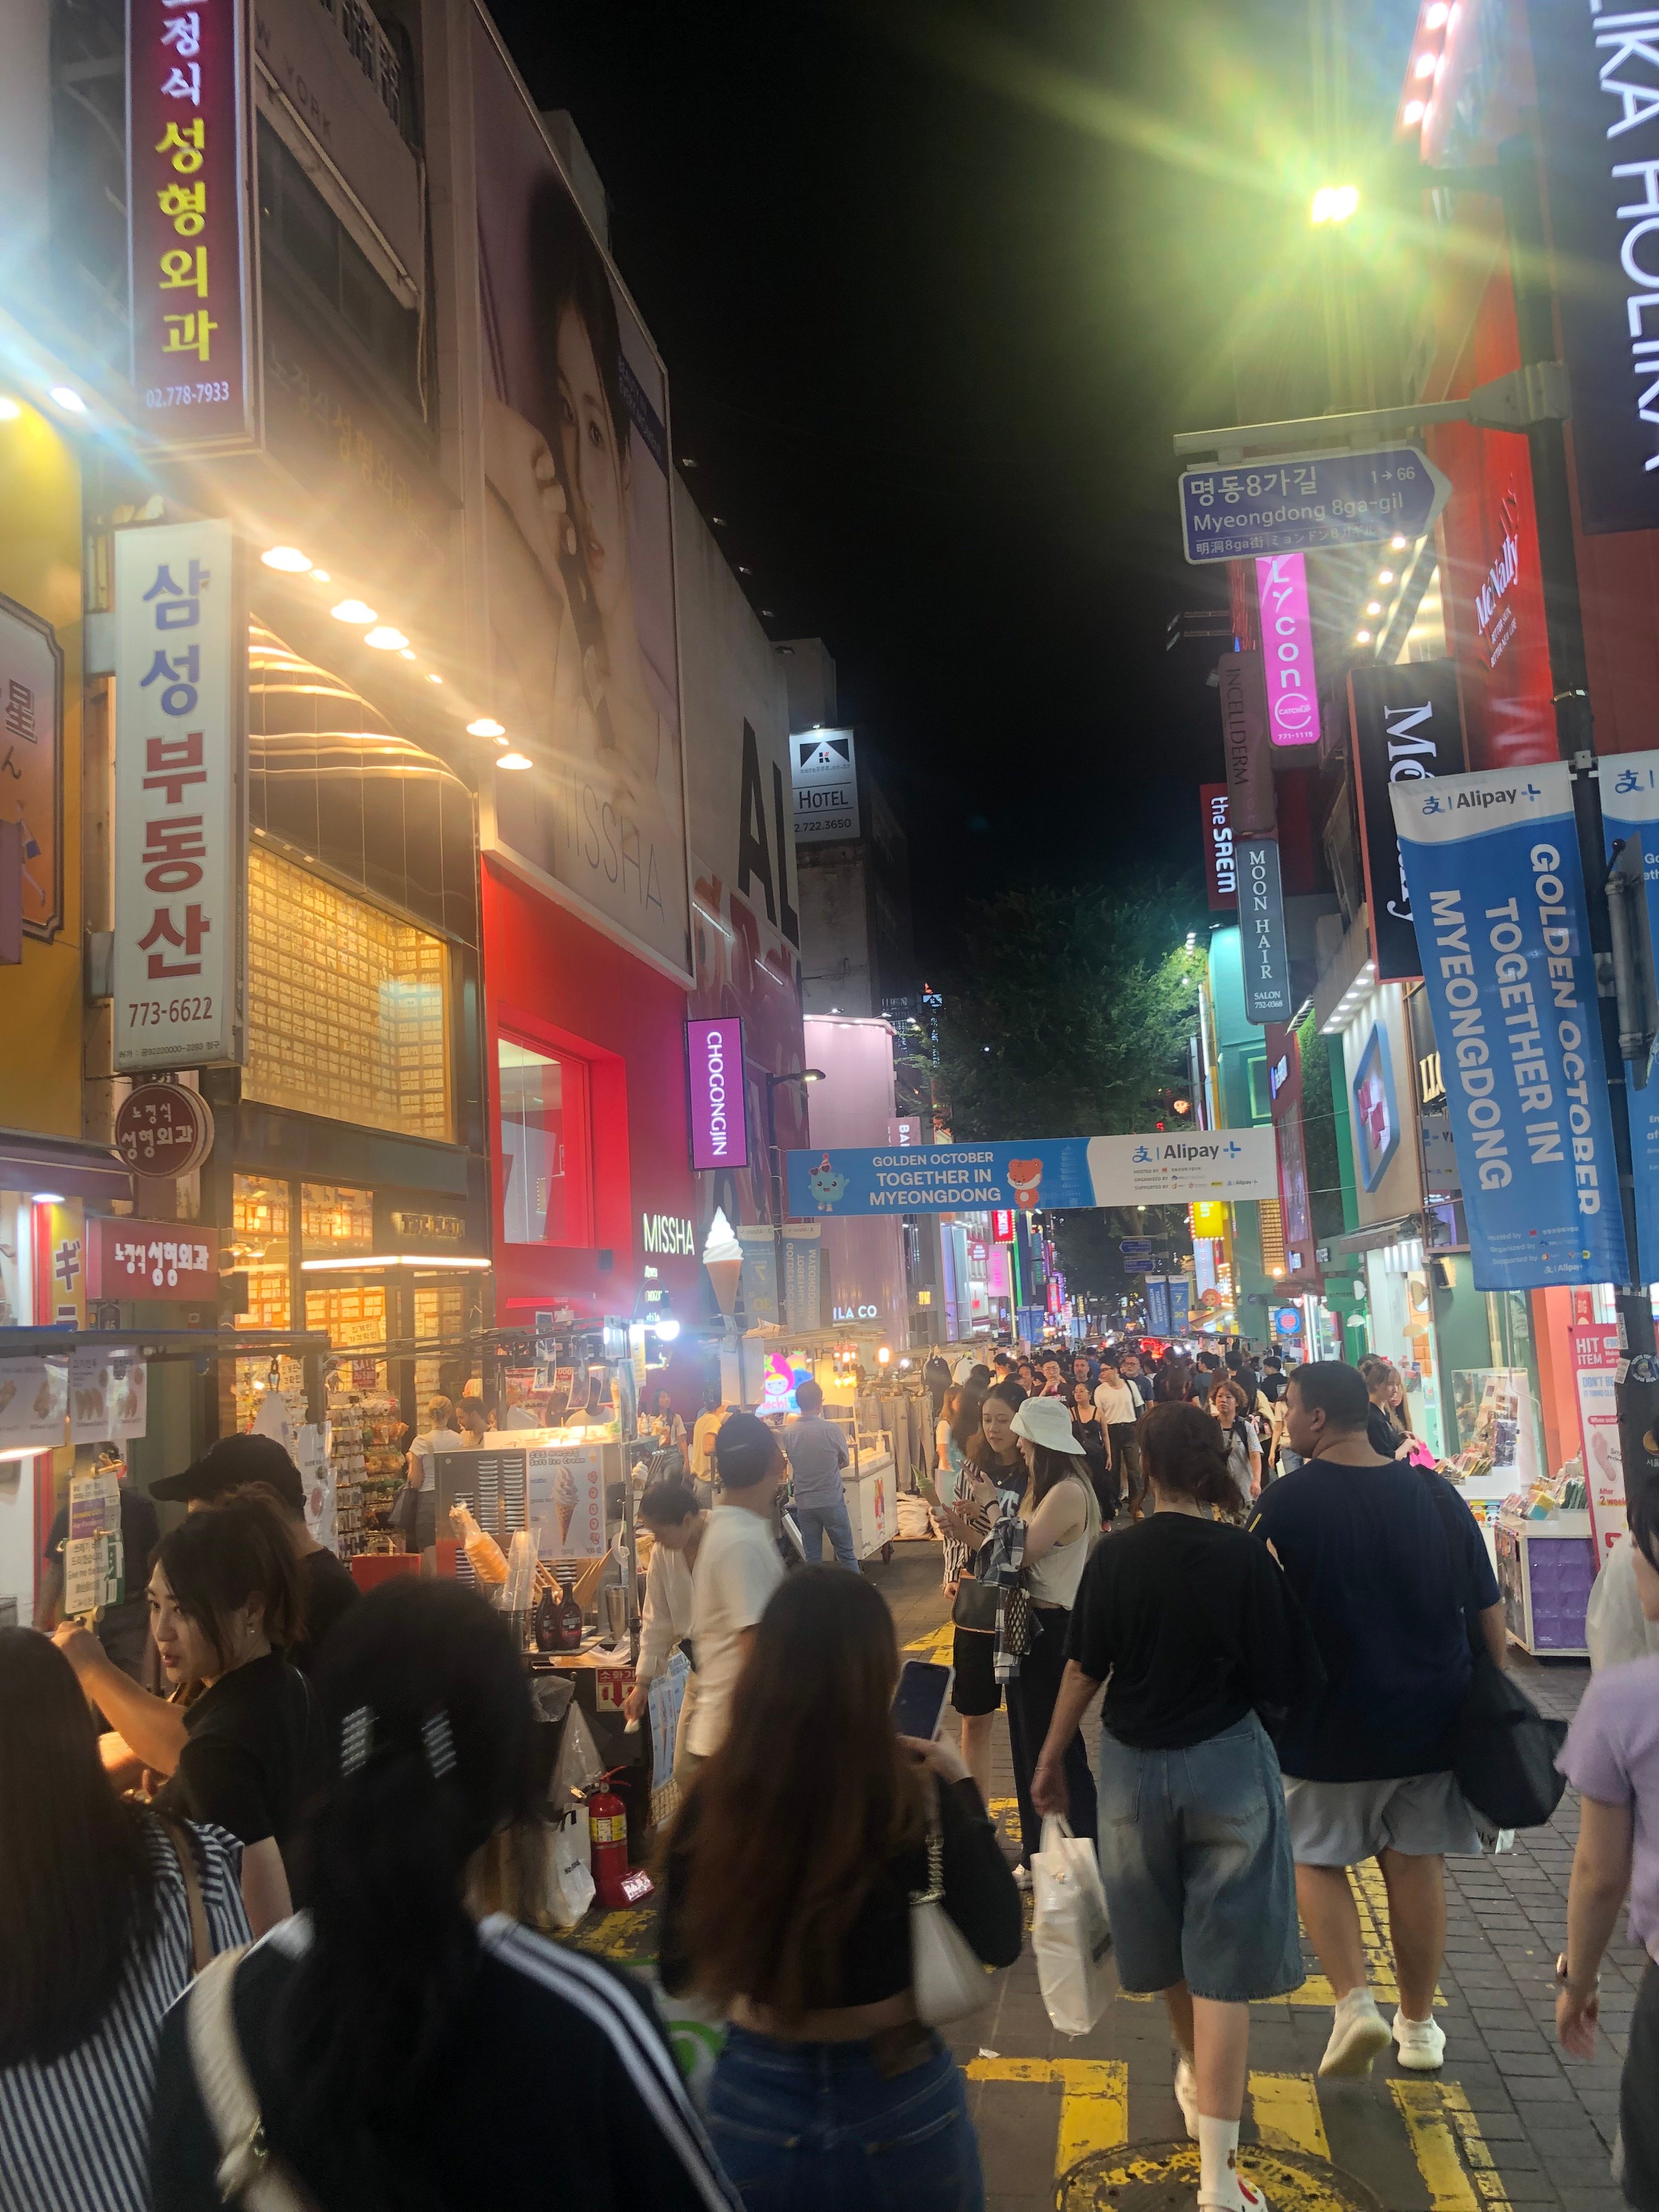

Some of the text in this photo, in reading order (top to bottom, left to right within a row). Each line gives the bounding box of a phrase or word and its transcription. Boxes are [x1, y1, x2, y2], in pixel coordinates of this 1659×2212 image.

[161, 0, 203, 106] 정식
[1588, 0, 1659, 139] IKA
[155, 118, 218, 362] 성형외과
[146, 381, 230, 408] 02.778-7933
[1191, 466, 1317, 507] 명동8가길
[1396, 466, 1416, 481] 66
[1194, 492, 1404, 531] Myeongdong 8ga-gil
[1196, 537, 1263, 555] 明洞8ga街
[1271, 560, 1301, 689] Lycon
[1226, 668, 1249, 785] INCELLDERM
[1278, 731, 1313, 740] 771-1119
[136, 558, 213, 980] 삼성 부동산
[794, 818, 851, 833] 2.722.3650
[1249, 850, 1273, 980] MOON HAIR
[1254, 991, 1281, 1001] SALON
[1254, 1000, 1283, 1008] 752-0368
[129, 996, 212, 1028] 773-6622
[1429, 889, 1513, 1190] MYEONGDONG
[1485, 896, 1553, 1114] TOGETHER
[1525, 1121, 1565, 1165] IN
[1530, 843, 1578, 1008] GOLDEN
[1559, 1020, 1601, 1215] OCTOBER
[706, 1031, 727, 1156] CHOGONGJIN
[132, 1102, 172, 1124] 노정식
[121, 1125, 193, 1160] 성형외과
[899, 1124, 910, 1147] BA
[872, 1151, 994, 1167] GOLDEN OCTOBER
[876, 1169, 992, 1187] TOGETHER IN
[870, 1187, 1001, 1206] MYEONGDONG
[643, 1212, 695, 1256] MISSHA
[115, 1240, 209, 1286] 노정식 성형외과
[832, 1305, 878, 1319] ILA CO
[348, 1331, 379, 1342] 가격확인
[351, 1323, 372, 1333] 집게핀
[1576, 1338, 1600, 1354] HIT
[1578, 1353, 1602, 1365] ITEM
[1600, 1496, 1606, 1505] 2
[600, 1669, 635, 1680] 소화기
